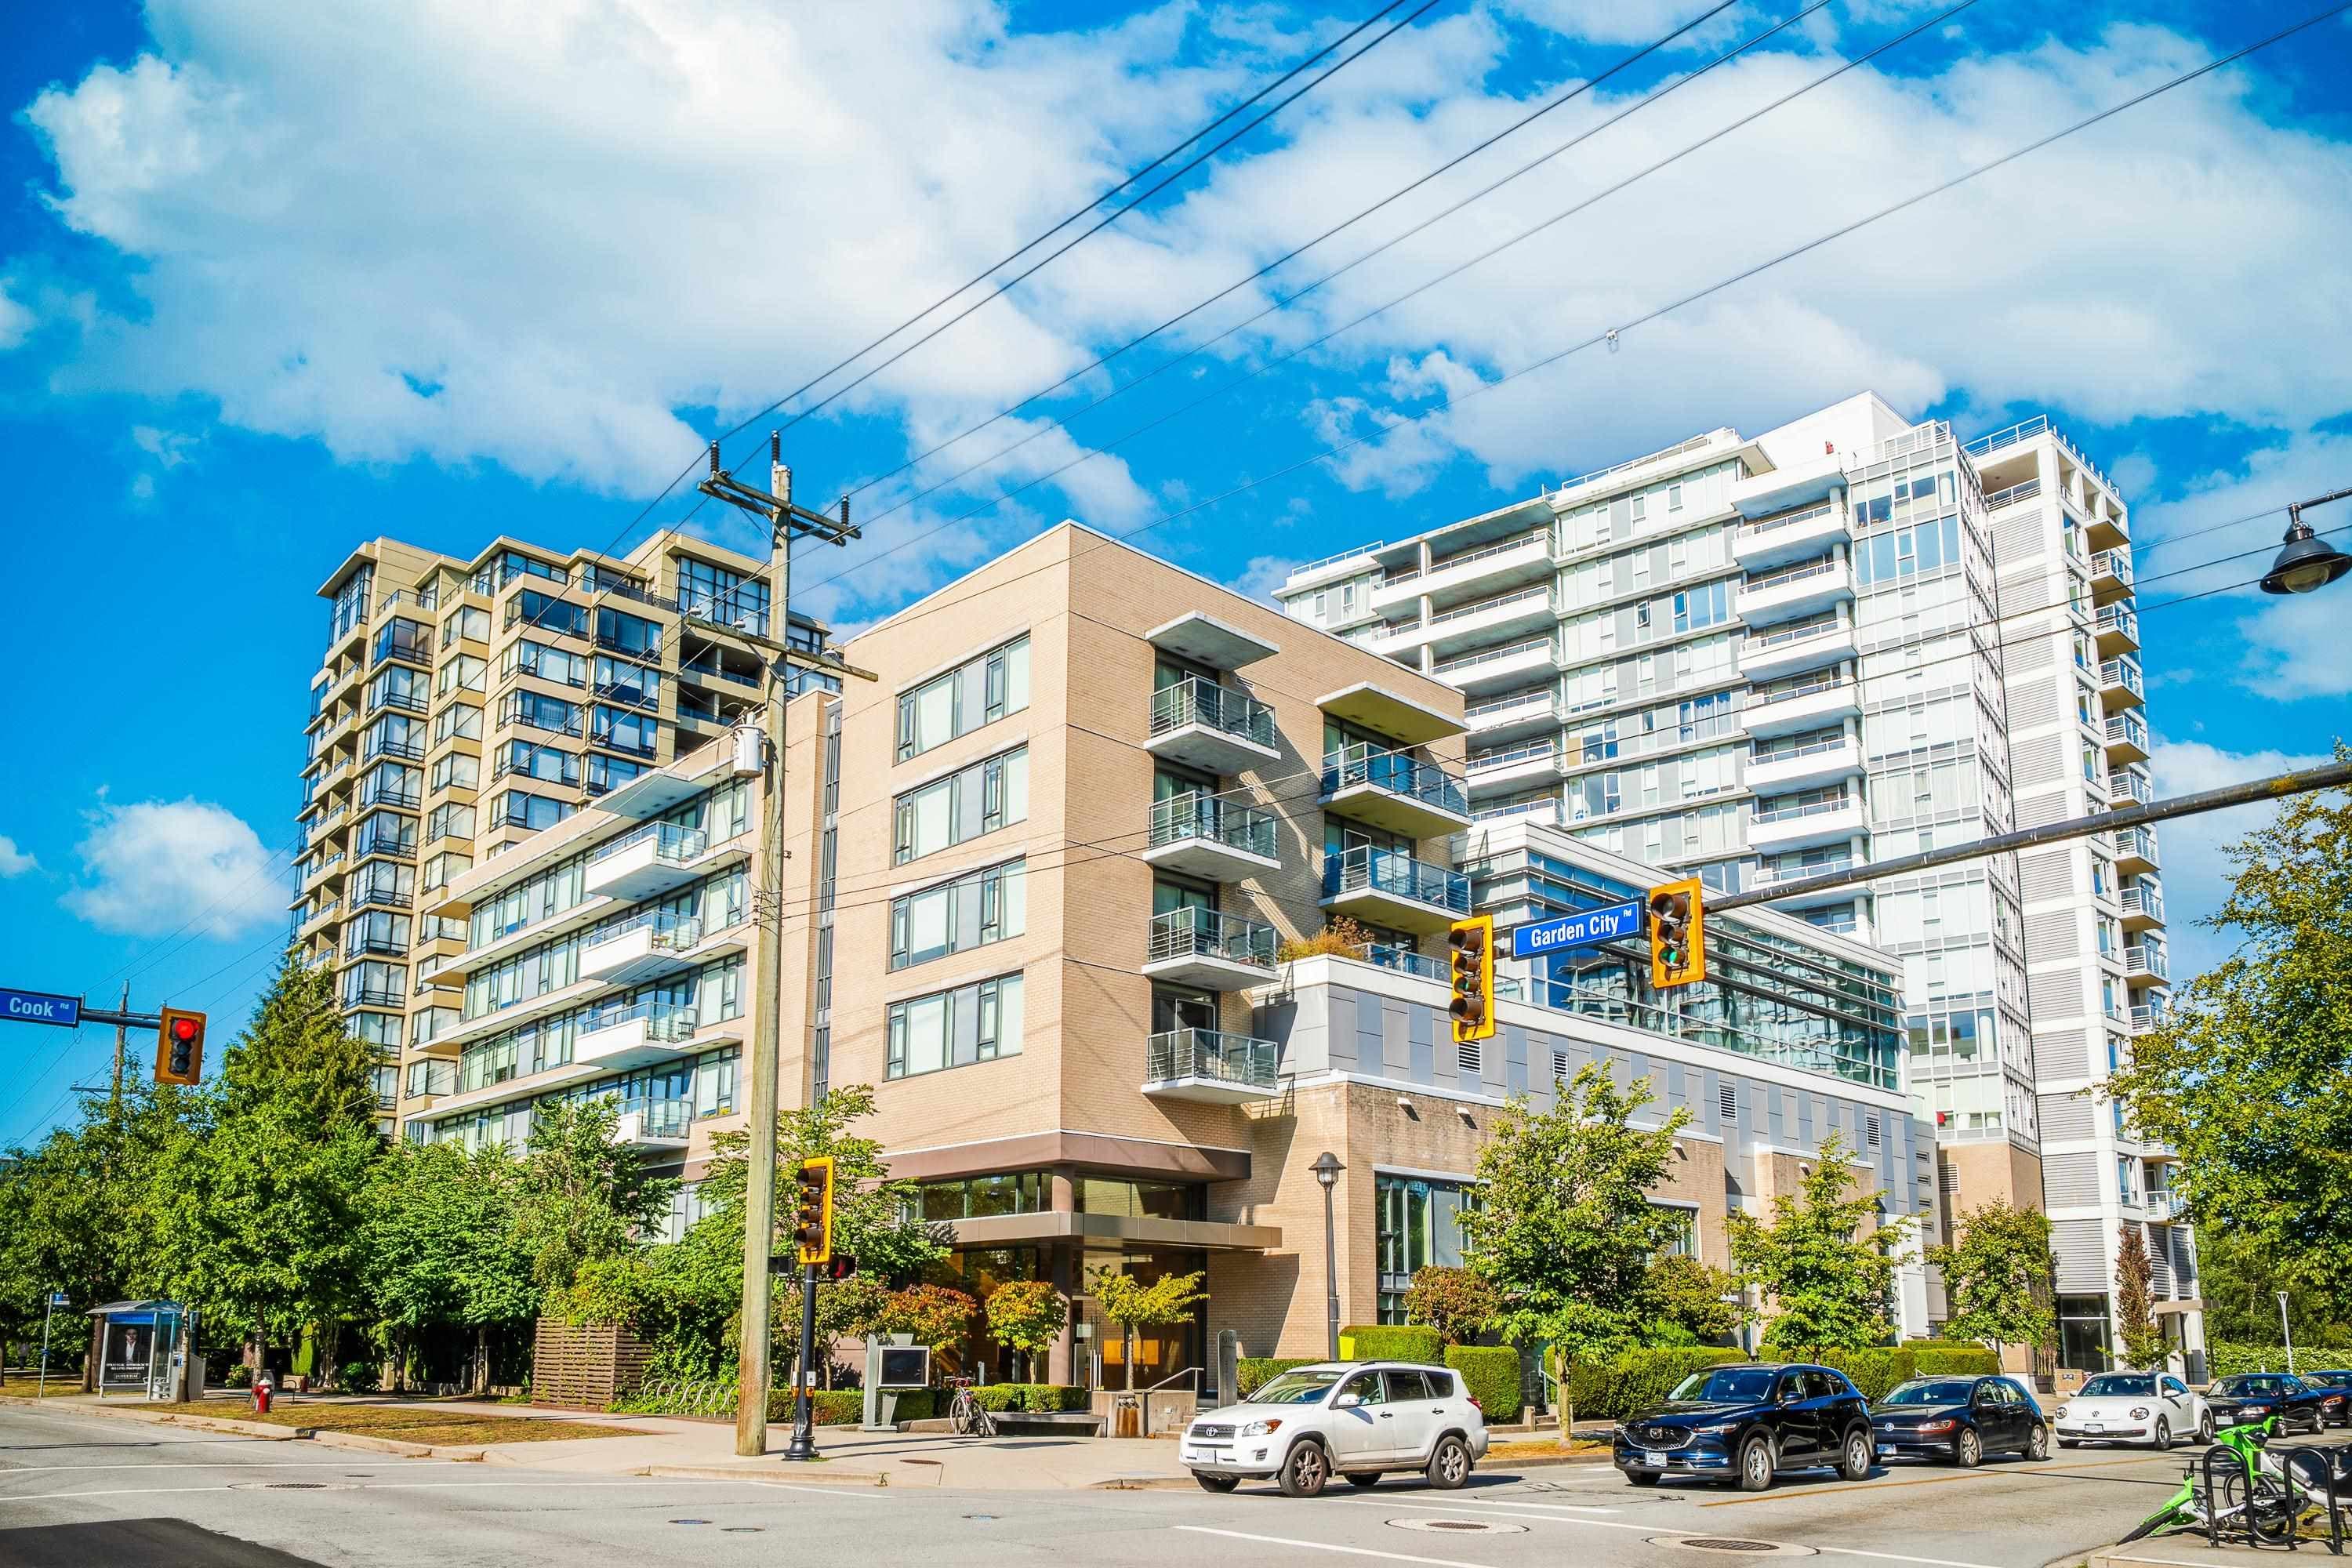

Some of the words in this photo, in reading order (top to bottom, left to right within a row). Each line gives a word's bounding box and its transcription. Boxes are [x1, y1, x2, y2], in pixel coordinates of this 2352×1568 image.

[1531, 924, 1584, 947] Garden
[1590, 915, 1619, 935] City
[9, 996, 53, 1017] Cook
